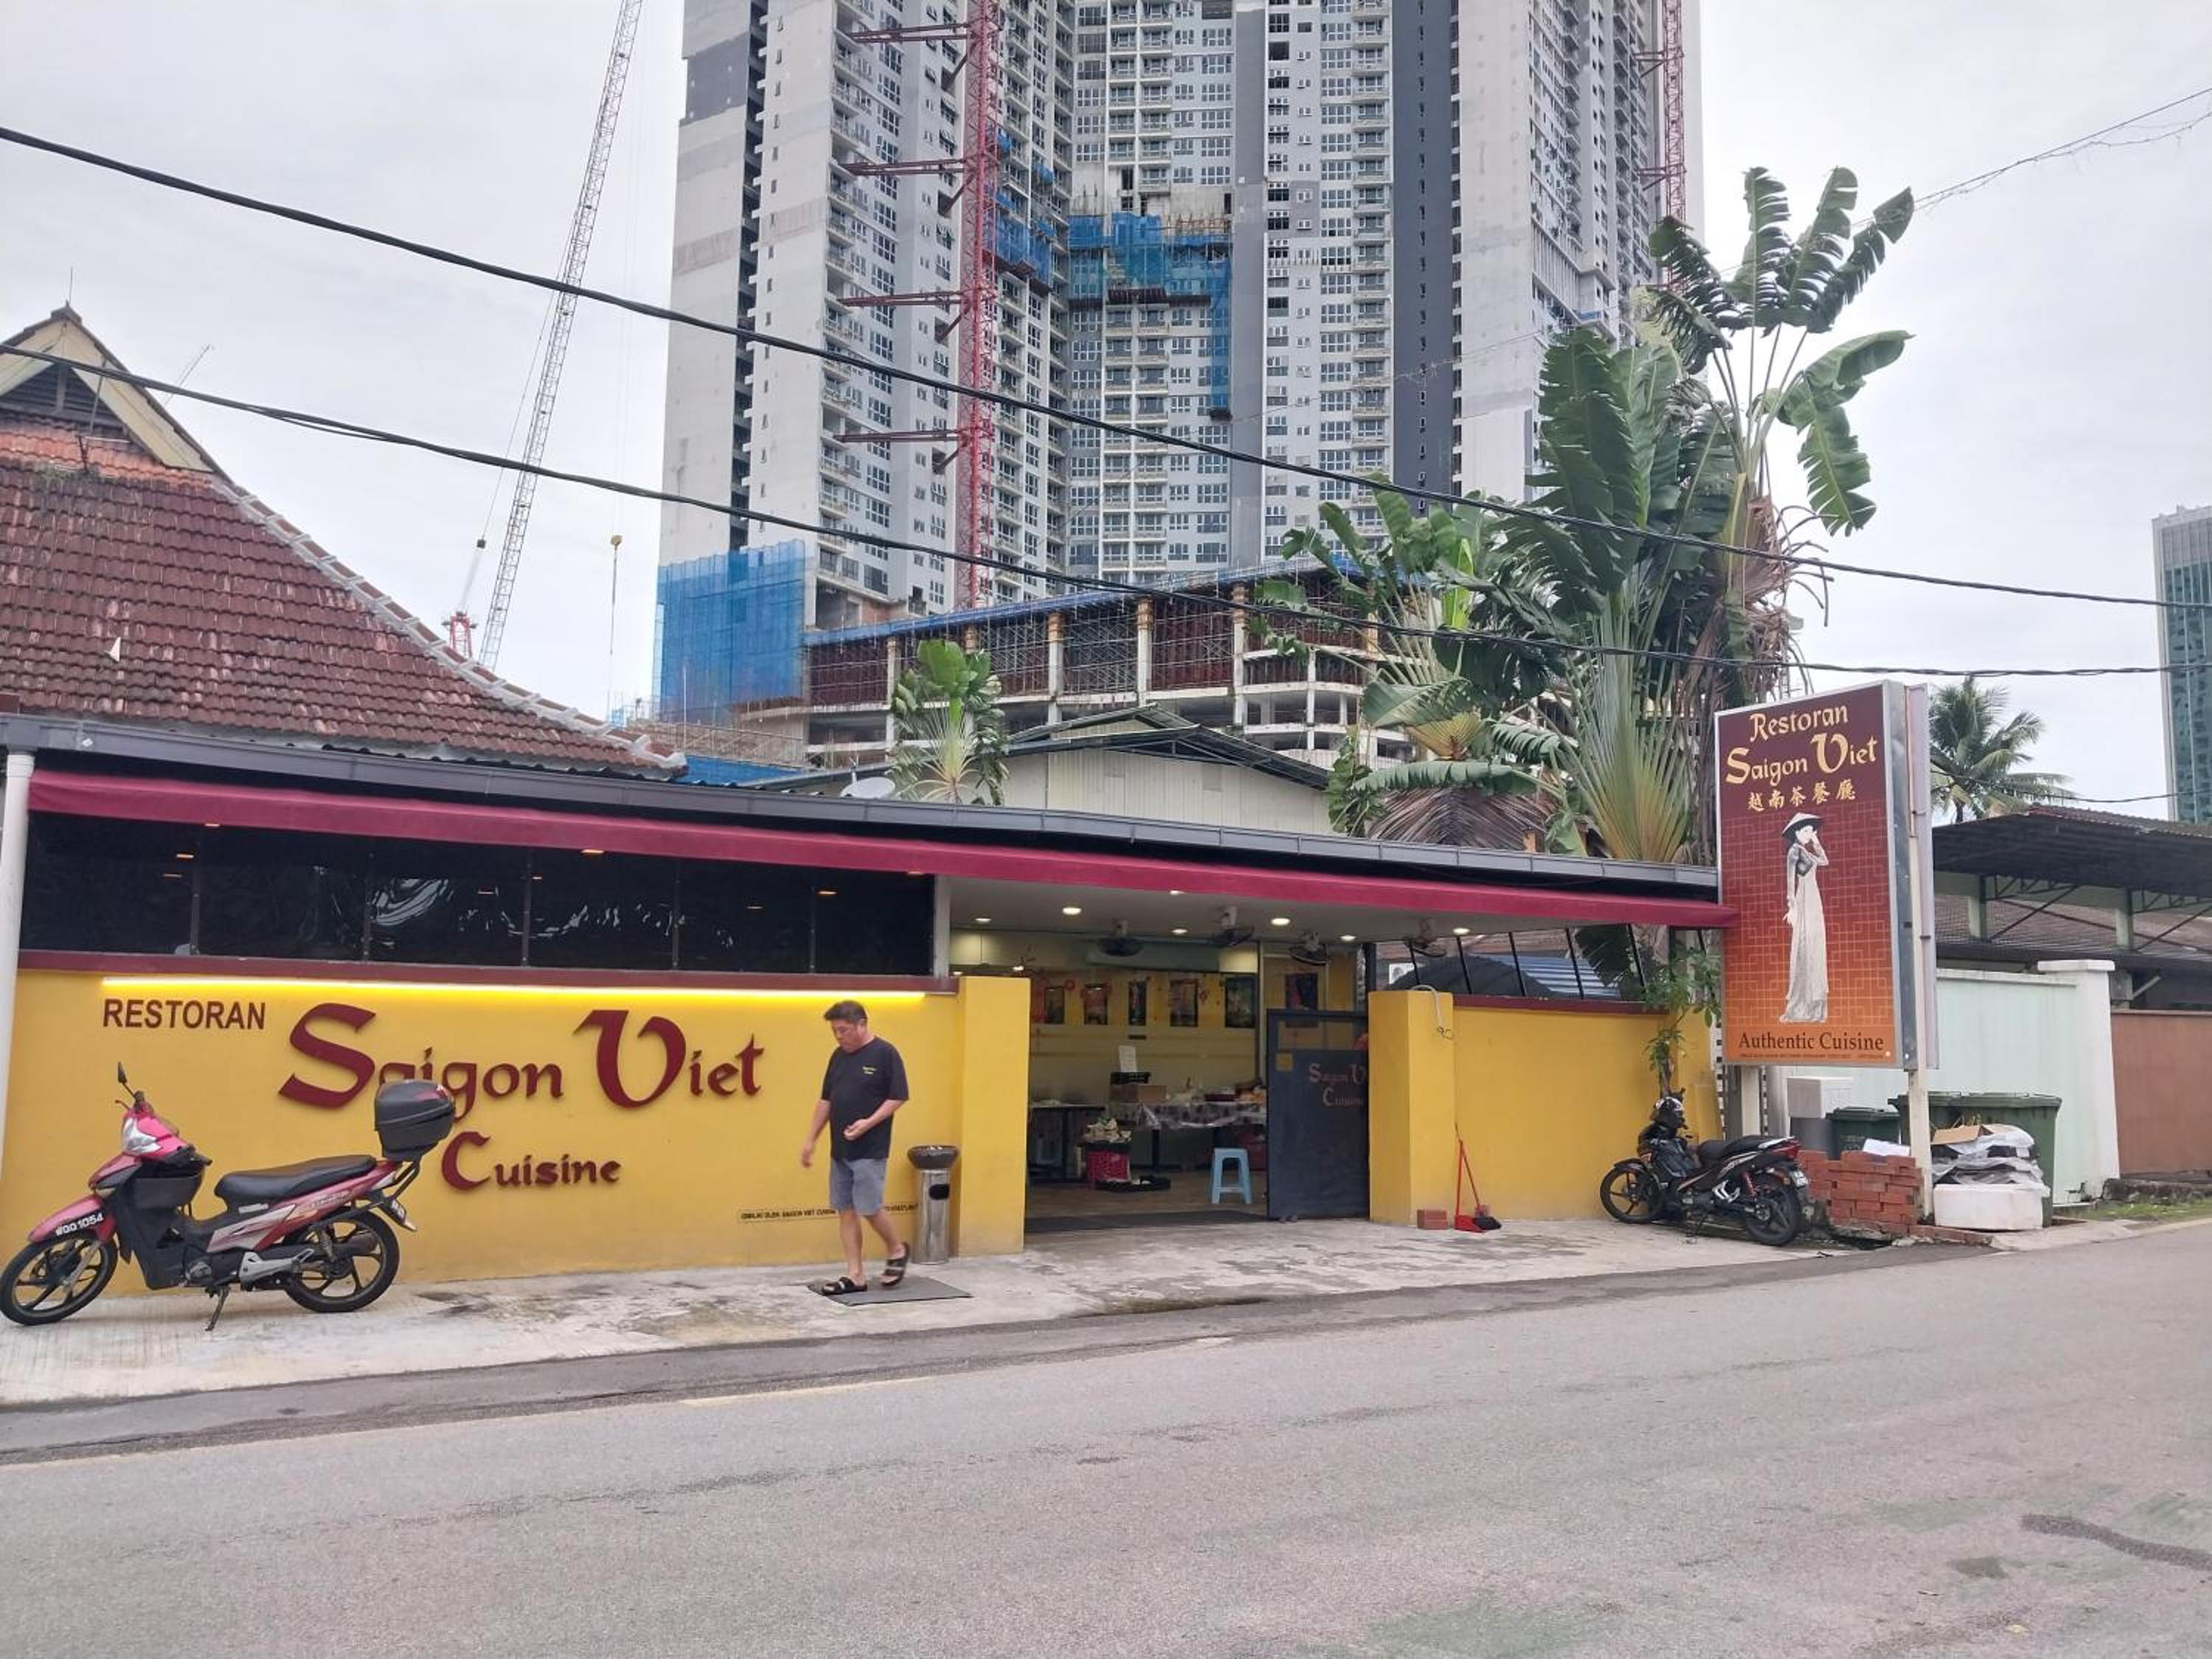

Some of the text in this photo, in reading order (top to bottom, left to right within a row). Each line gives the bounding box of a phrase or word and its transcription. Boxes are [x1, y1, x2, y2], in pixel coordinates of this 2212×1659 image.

[1750, 705, 1848, 742] Restoran
[1725, 732, 1878, 786] Saigon Viet
[102, 998, 265, 1029] RESTORAN
[279, 1003, 765, 1121] Saigon Viet
[1739, 1032, 1884, 1051] Authentic Cuisine
[441, 1131, 622, 1191] Cuisine
